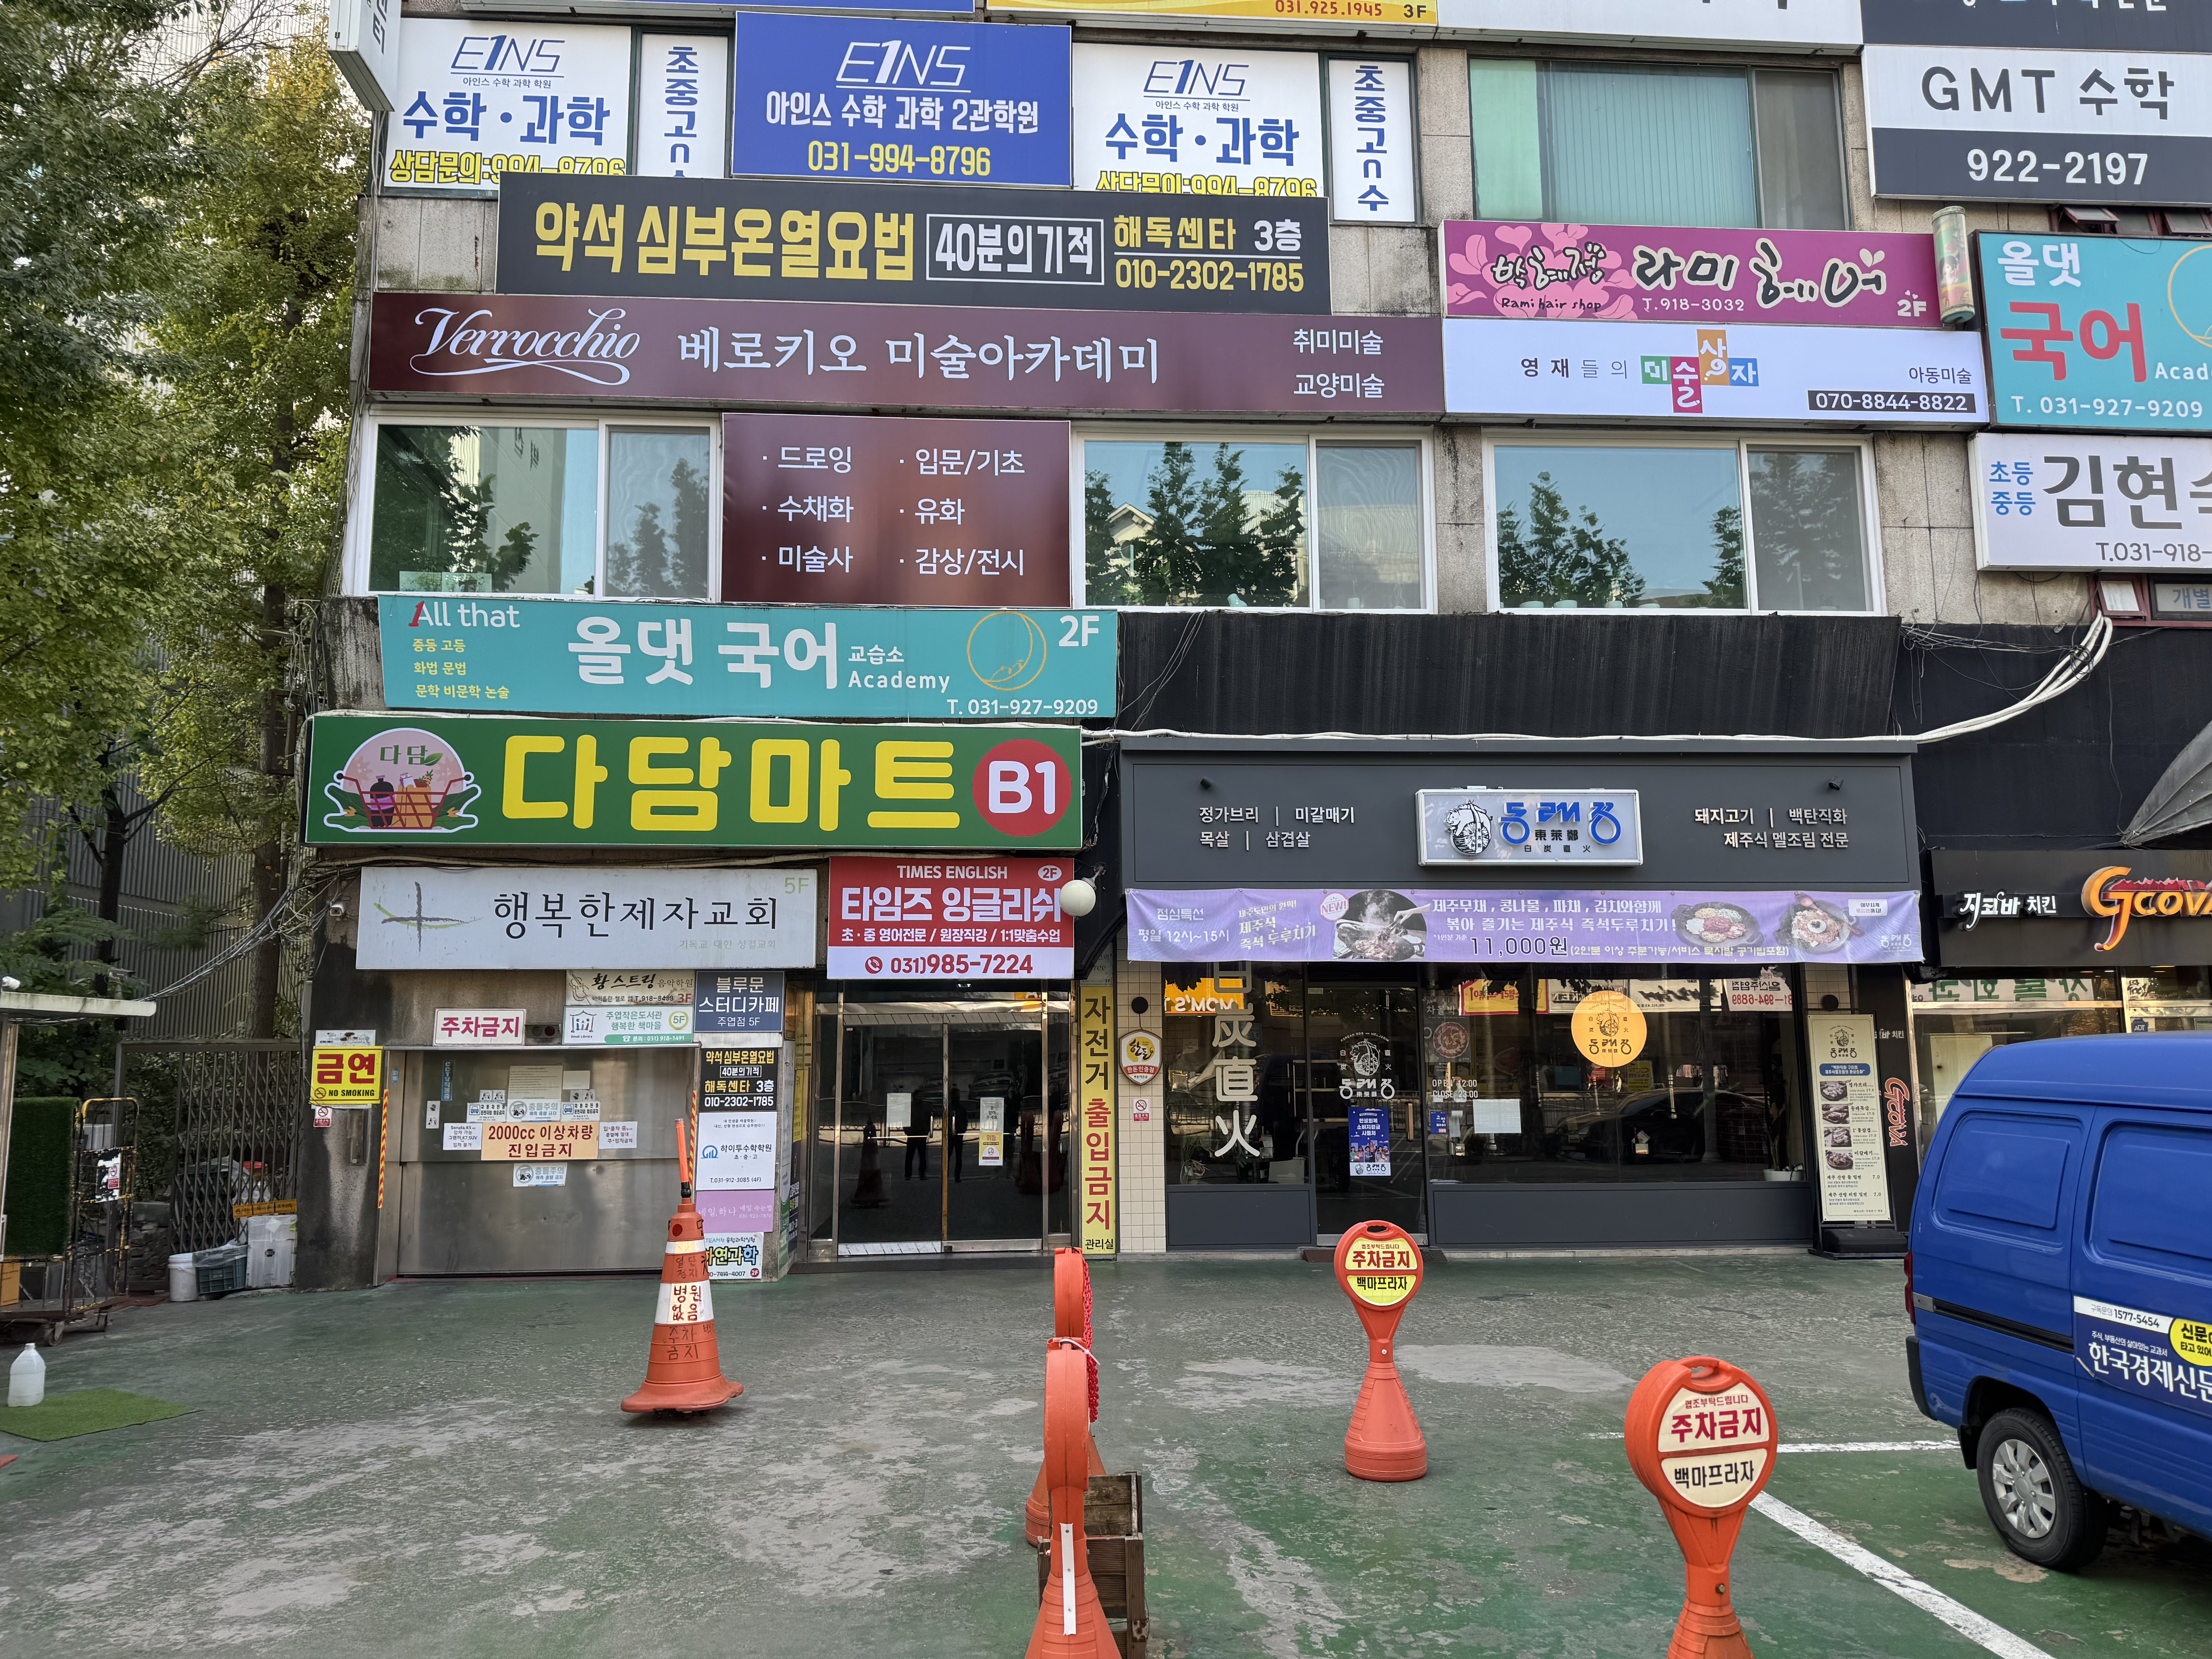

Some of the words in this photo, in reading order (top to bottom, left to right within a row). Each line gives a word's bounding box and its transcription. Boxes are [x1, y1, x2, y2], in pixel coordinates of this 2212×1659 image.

[1403, 4, 1427, 18] 3F
[463, 78, 489, 86] 아인스
[492, 79, 510, 87] 수학
[513, 79, 531, 88] 과학
[533, 80, 551, 89] 학원
[1922, 67, 2055, 113] GMT
[2080, 68, 2174, 120] 수학
[766, 91, 831, 127] 아인스
[842, 95, 886, 128] 수학
[896, 96, 943, 130] 과학
[953, 99, 1038, 134] 2관학원
[1156, 101, 1181, 110] 아인스
[1183, 101, 1200, 110] 수학
[1202, 103, 1219, 111] 과학
[1222, 103, 1239, 112] 학원
[809, 140, 990, 176] 031-994-8796
[1967, 149, 2148, 185] 922-2197
[535, 202, 624, 273] 약석
[637, 206, 914, 280] 심부온열요법
[1114, 215, 1235, 251] 해독센타
[1254, 219, 1302, 252] 3층
[1632, 245, 1739, 292] 라미
[1998, 241, 2081, 287] 올댓
[1115, 259, 1304, 292] 010-2302-1785
[1502, 297, 1534, 308] Rami
[1573, 299, 1601, 310] shop
[1898, 299, 1927, 317] 2F
[410, 307, 640, 377] Verrocchio
[1293, 329, 1383, 356] 취미미술
[2000, 301, 2146, 382] 국어
[677, 326, 867, 375] 베로키오
[886, 332, 1158, 384] 미술아카데미
[1909, 366, 1972, 384] 아동미술
[1293, 373, 1385, 398] 교양미술
[1816, 392, 1968, 410] 070-8844-8822
[2040, 397, 2203, 417] 031-927-9209
[778, 446, 852, 473] 드로잉
[915, 449, 1025, 476] 입문/기초
[1989, 461, 2033, 486] 초등
[778, 496, 854, 522] 수채화
[915, 499, 965, 524] 유화
[1991, 491, 2036, 515] 중등
[779, 546, 853, 573] 미술사
[915, 549, 1024, 576] 감상/전시
[458, 603, 520, 628] that
[1059, 615, 1099, 647] 2F
[413, 639, 437, 652] 중등
[441, 640, 465, 653] 고등
[568, 617, 694, 685] 올댓
[718, 622, 837, 689] 국어
[848, 645, 904, 663] 교습소
[414, 662, 437, 675] 화법
[442, 662, 466, 675] 문법
[416, 684, 440, 698] 문학
[443, 685, 481, 698] 비문학
[485, 685, 509, 699] 논술
[848, 671, 950, 694] Academy
[968, 699, 1098, 715] 031-927-9209
[379, 745, 429, 766] 다담
[502, 735, 960, 831] 다담마트
[988, 760, 1056, 814] B1
[1199, 806, 1259, 824] 정가브리
[1295, 806, 1355, 824] 미갈매기
[1695, 808, 1753, 825] 돼지고기
[1788, 809, 1847, 825] 백탄직화
[1200, 831, 1230, 848] 목살
[1266, 831, 1310, 848] 삼겹살
[1724, 831, 1767, 848] 제주식
[1773, 831, 1815, 848] 멜조림
[1820, 832, 1848, 848] 전문
[897, 865, 941, 879] TIMES
[946, 866, 1007, 879] ENGLISH
[1043, 868, 1057, 878] 2F
[493, 891, 776, 940] 행복한제자교회
[784, 878, 809, 894] 5F
[842, 887, 932, 921] 타임즈
[942, 887, 1061, 922] 잉글리쉬
[1322, 901, 1346, 913] NEW!
[1594, 900, 1661, 913] 김치와함께
[1960, 892, 2020, 929] 지코바
[2027, 895, 2056, 914] 치킨
[1157, 908, 1204, 921] 점심특선
[1239, 917, 1276, 934] 제주식
[1447, 917, 1475, 931] 볶아
[1482, 918, 1524, 931] 즐기는
[1530, 918, 1573, 931] 제주식
[879, 928, 926, 941] 영어전문
[940, 929, 988, 941] 원장직강
[1138, 929, 1161, 942] 평일
[1240, 936, 1263, 950] 즉석
[1268, 922, 1315, 945] 두루치기
[679, 939, 708, 950] 기독교
[713, 939, 733, 950] 대한
[1471, 936, 1568, 956] 11,000원
[1605, 946, 1624, 955] 이상
[891, 954, 1032, 974] 031)985-7224
[610, 973, 656, 988] 스트링
[658, 979, 693, 988] 음악학원
[717, 977, 764, 993] 블루문
[678, 993, 691, 1003] 3F
[699, 997, 779, 1013] 스터디카페
[606, 1011, 662, 1019] 주엽작은도서관
[718, 1017, 745, 1026] 주엽점
[749, 1017, 760, 1026] 5F
[441, 1016, 519, 1037] 주차금지
[611, 1022, 635, 1030] 행복한
[638, 1022, 661, 1030] 책마을
[706, 1051, 723, 1064] 약석
[317, 1053, 375, 1084] 금연
[705, 1080, 750, 1092] 해독센타
[756, 1080, 774, 1092] 3층
[705, 1096, 773, 1107] 010-2302-1785
[488, 1126, 534, 1140] 2000cc
[540, 1125, 593, 1140] 이상차량
[508, 1143, 572, 1158] 진입금지
[721, 1144, 771, 1152] 하이투수학학원
[1085, 1239, 1114, 1250] 관리실
[1352, 1251, 1410, 1268] 주차금지
[1357, 1276, 1407, 1290] 백마프라자
[2114, 1309, 2159, 1328] 1577-5454
[2105, 1334, 2126, 1346] 부동산의
[2150, 1345, 2167, 1356] 교과서
[2181, 1342, 2195, 1353] 타고
[1685, 1395, 1748, 1409] 협조부탁드립니다
[1671, 1407, 1762, 1443] 주차금지
[1674, 1461, 1754, 1489] 백마프라자
